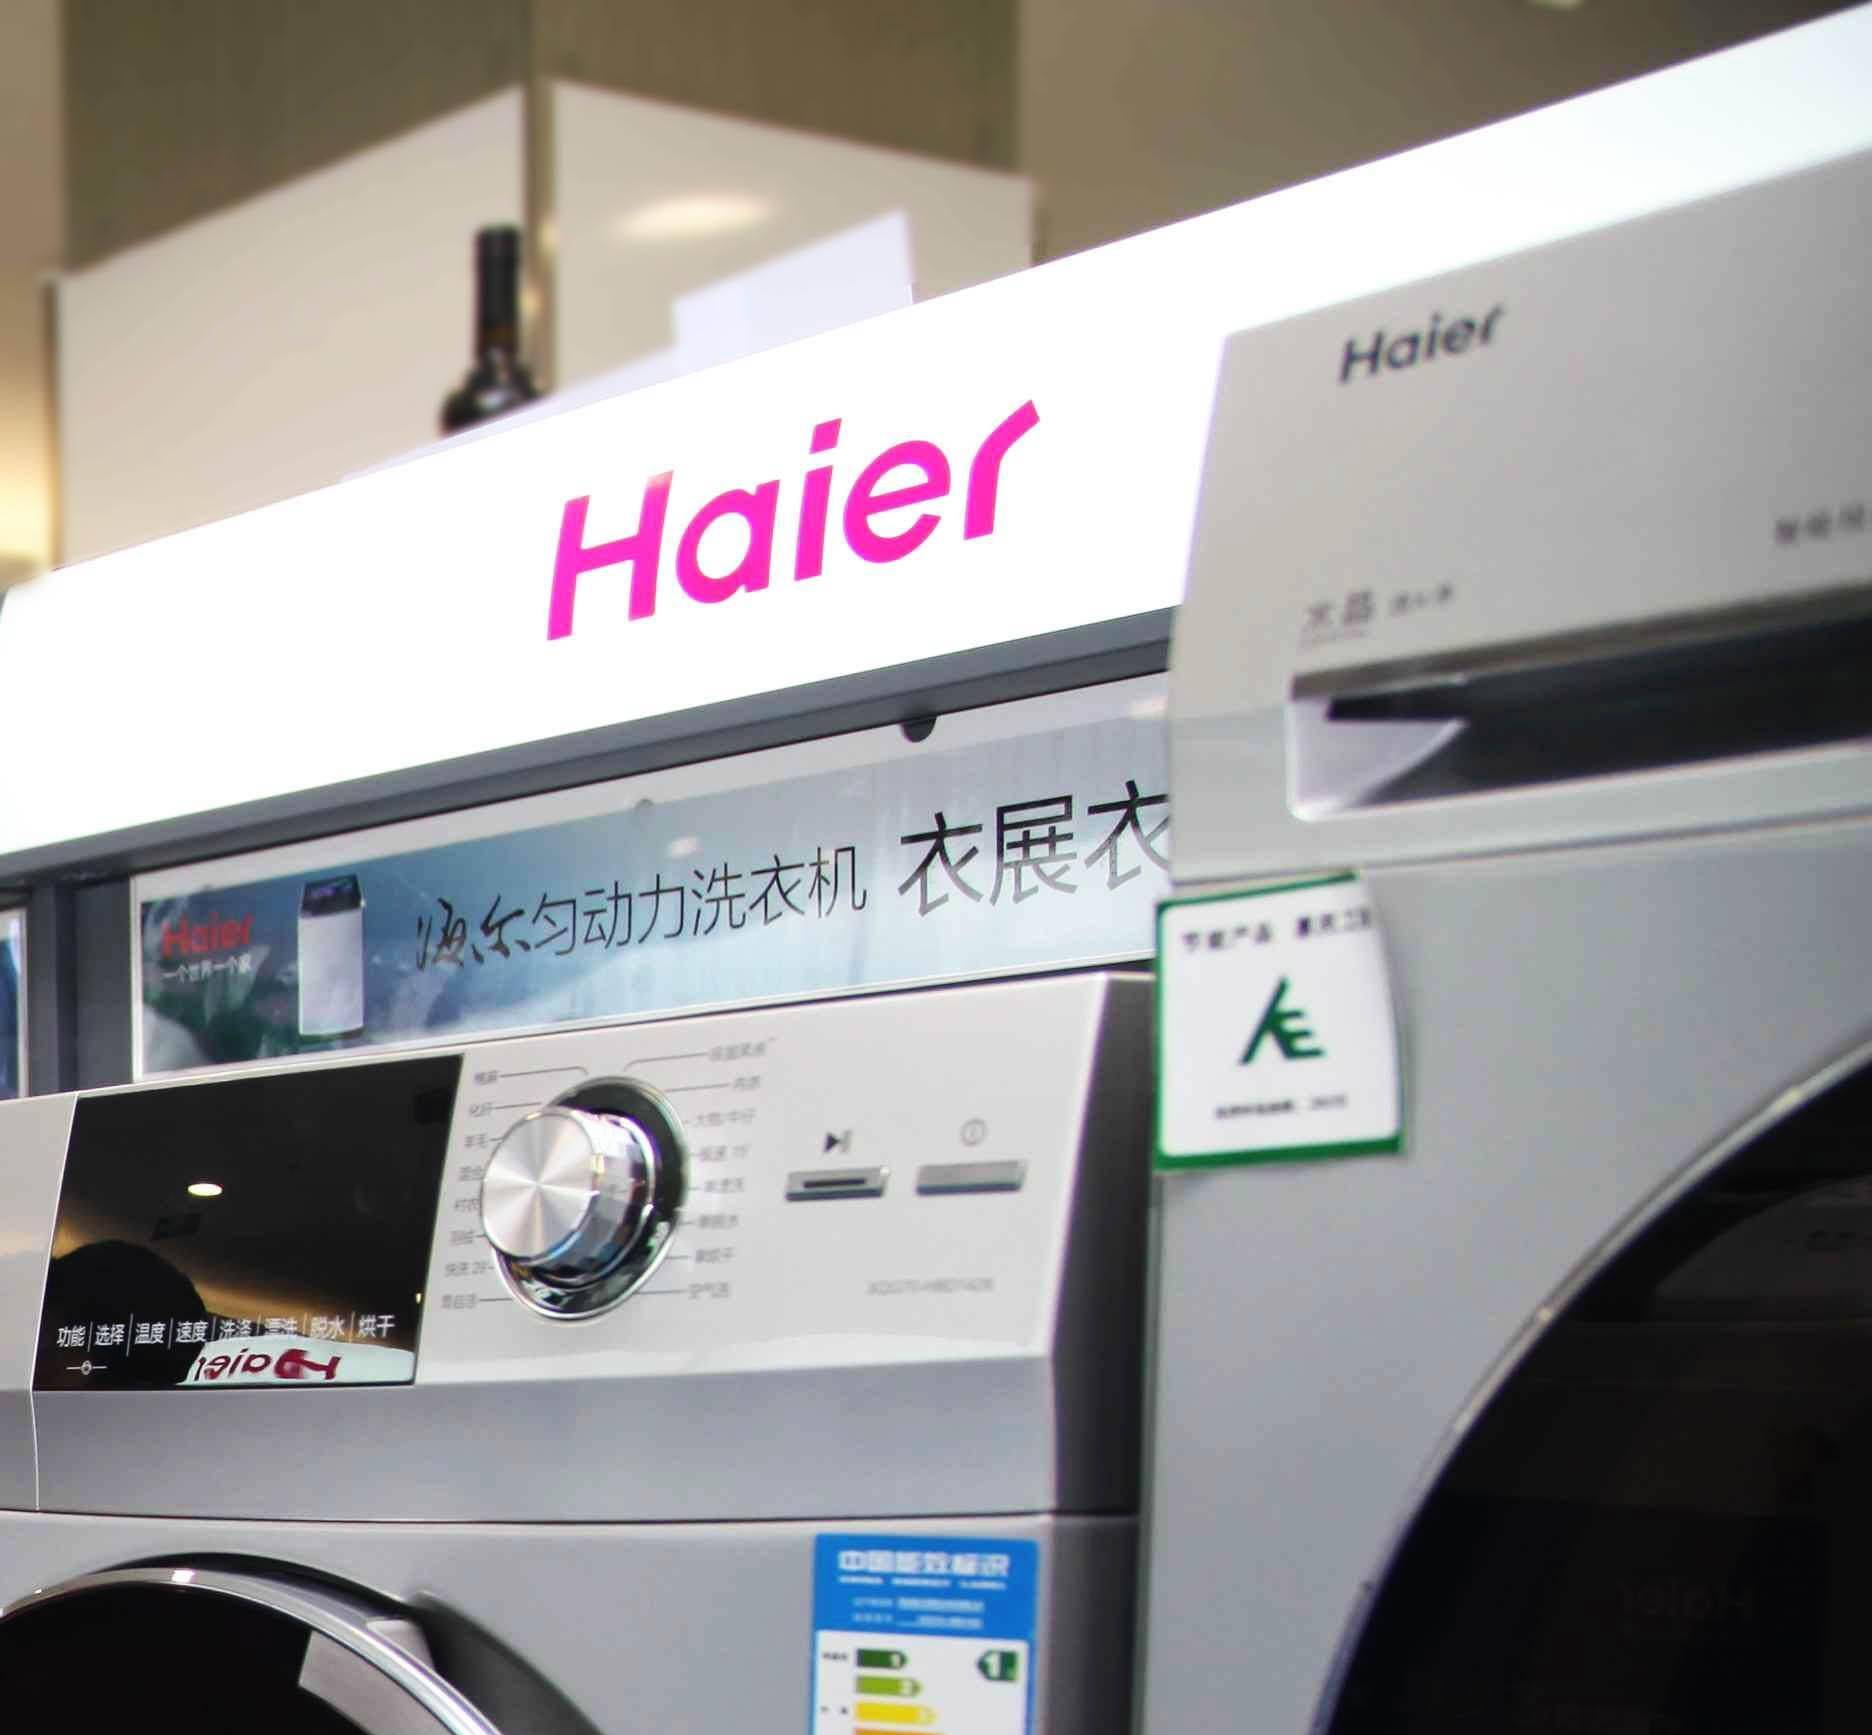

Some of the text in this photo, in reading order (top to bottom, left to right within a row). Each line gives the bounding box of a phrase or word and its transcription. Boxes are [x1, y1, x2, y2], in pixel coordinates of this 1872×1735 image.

[1339, 303, 1505, 384] Haier
[547, 400, 1039, 641] Haier
[159, 911, 255, 960] Haier
[57, 1326, 85, 1348] 功能
[95, 1324, 125, 1346] 选择
[135, 1322, 167, 1345] 温度
[175, 1321, 208, 1344] 速度
[358, 1314, 396, 1339] 烘干
